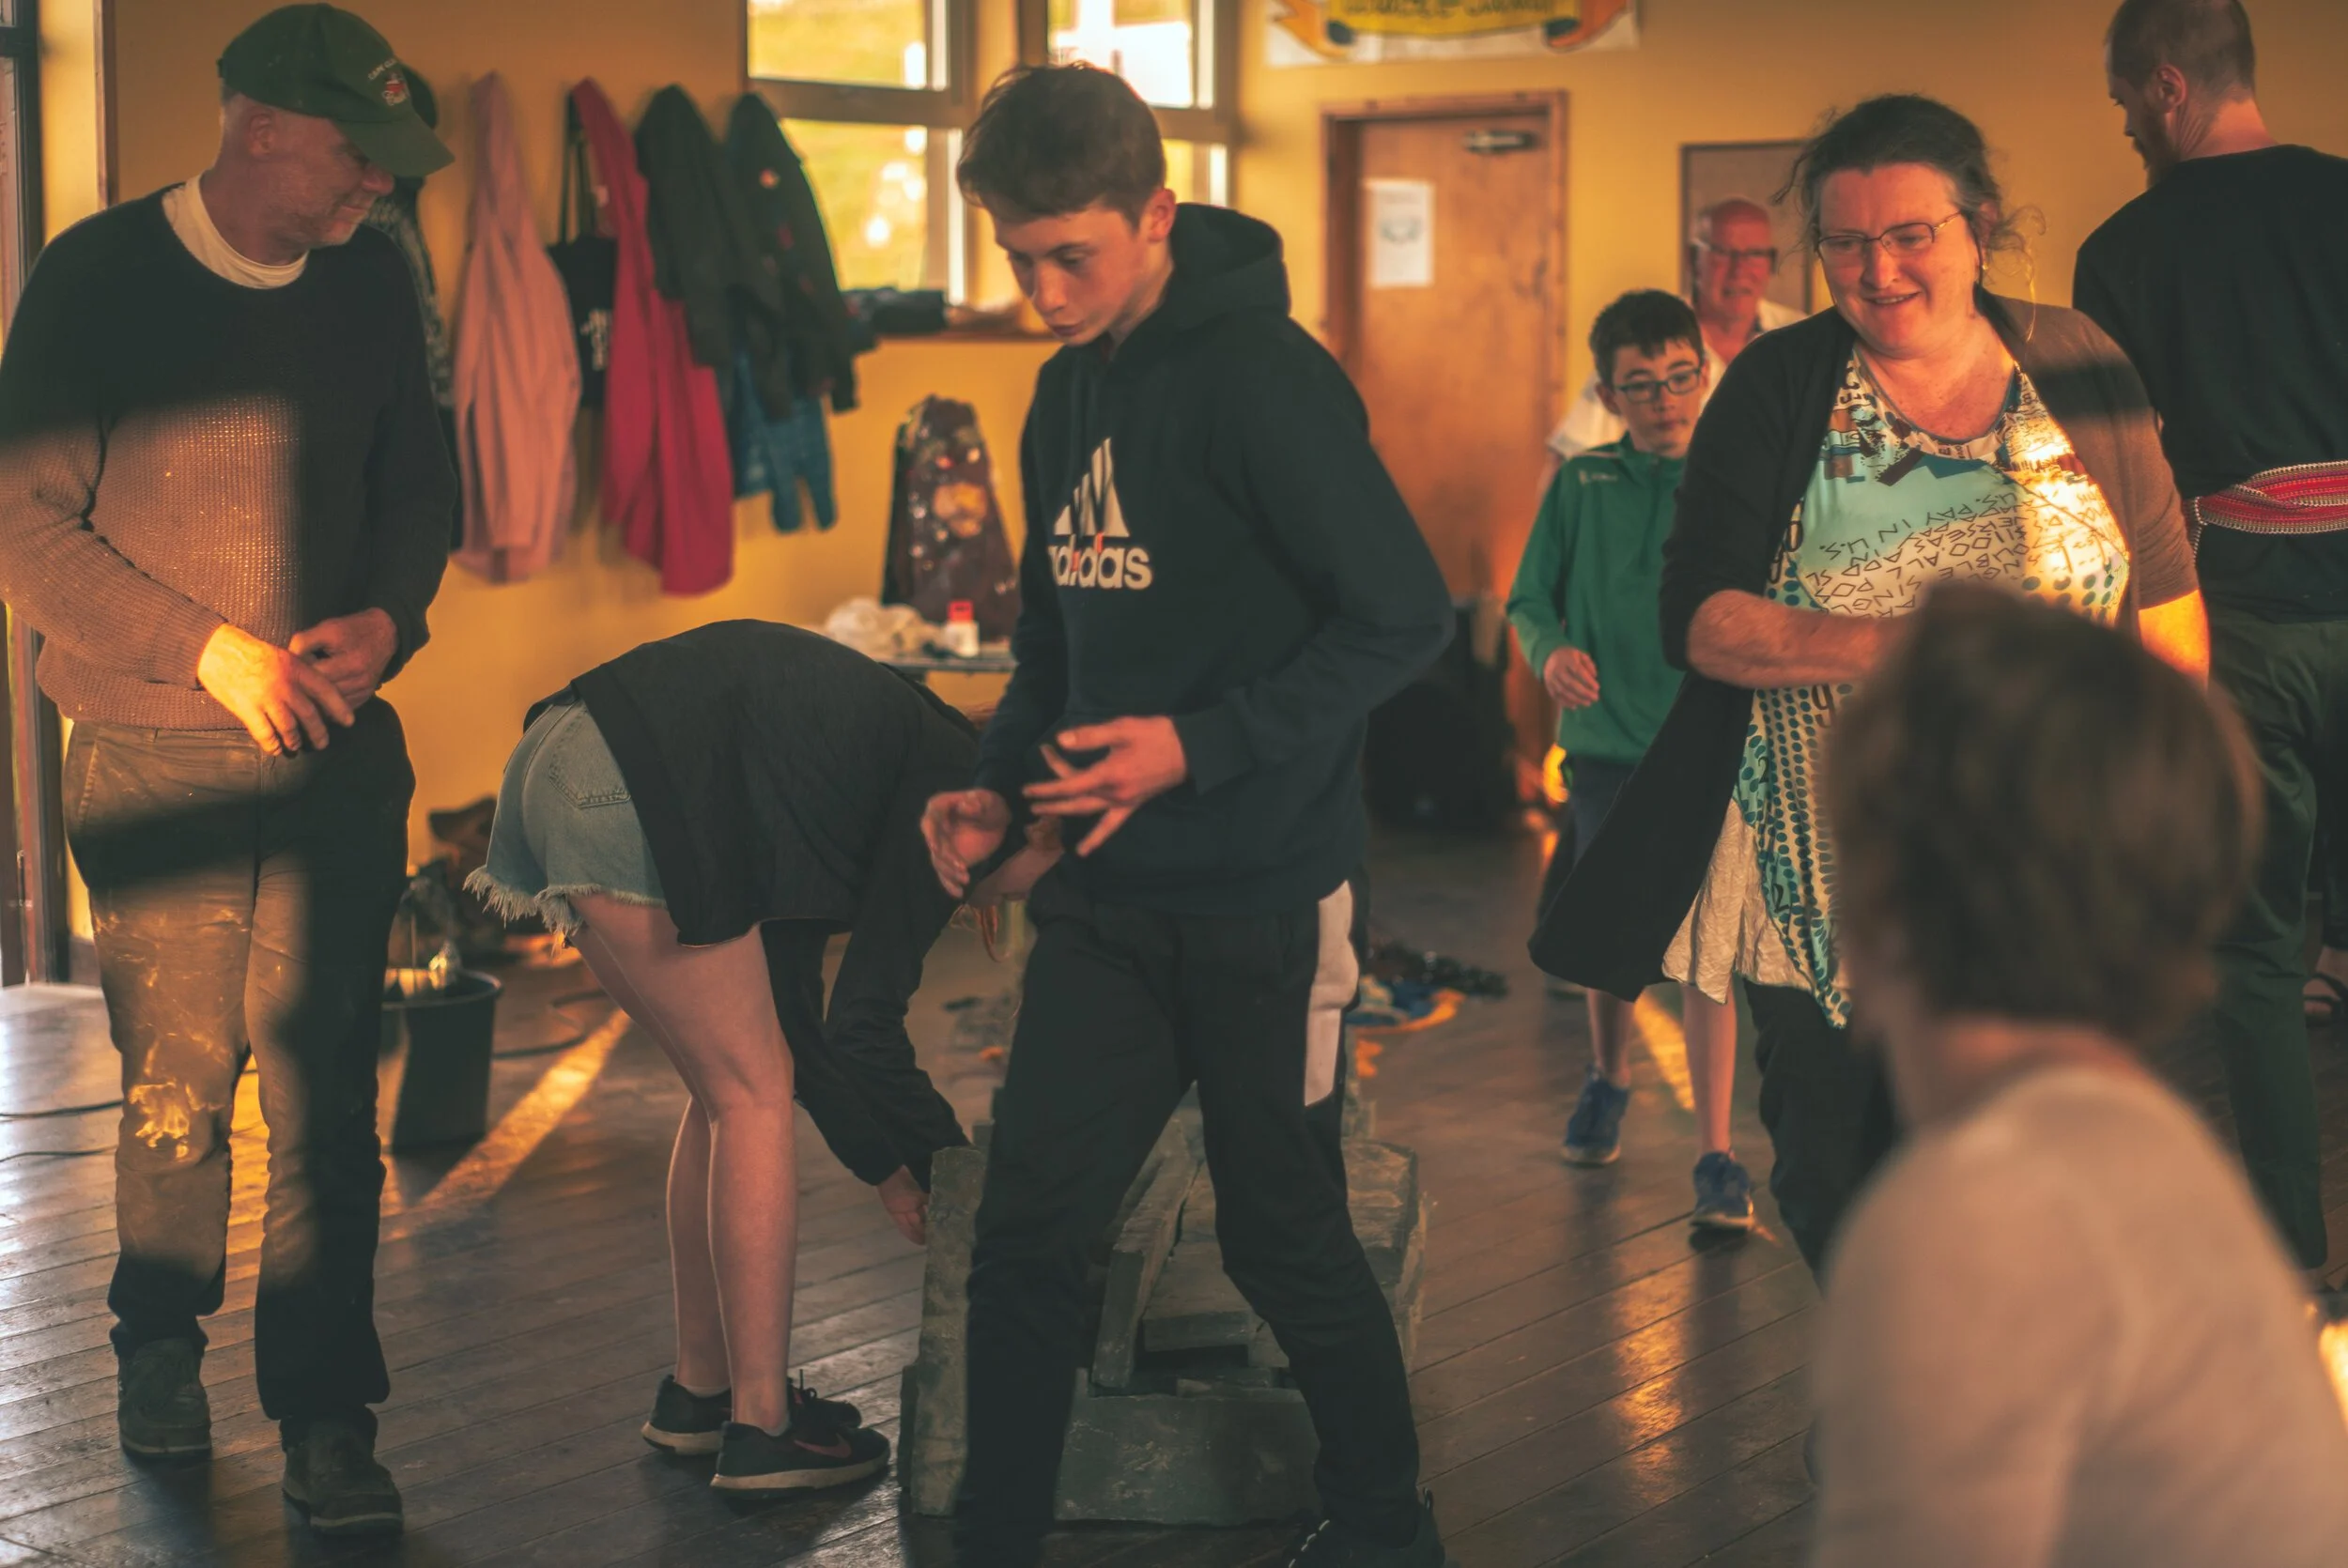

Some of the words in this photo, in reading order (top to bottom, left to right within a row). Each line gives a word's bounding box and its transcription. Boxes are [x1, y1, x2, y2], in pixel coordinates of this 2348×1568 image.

[1925, 503, 1973, 526] PAY
[1877, 518, 1911, 544] IN
[1896, 521, 1951, 550] PAY
[1818, 537, 1870, 561] U.S.
[1831, 575, 1923, 615] SINGL
